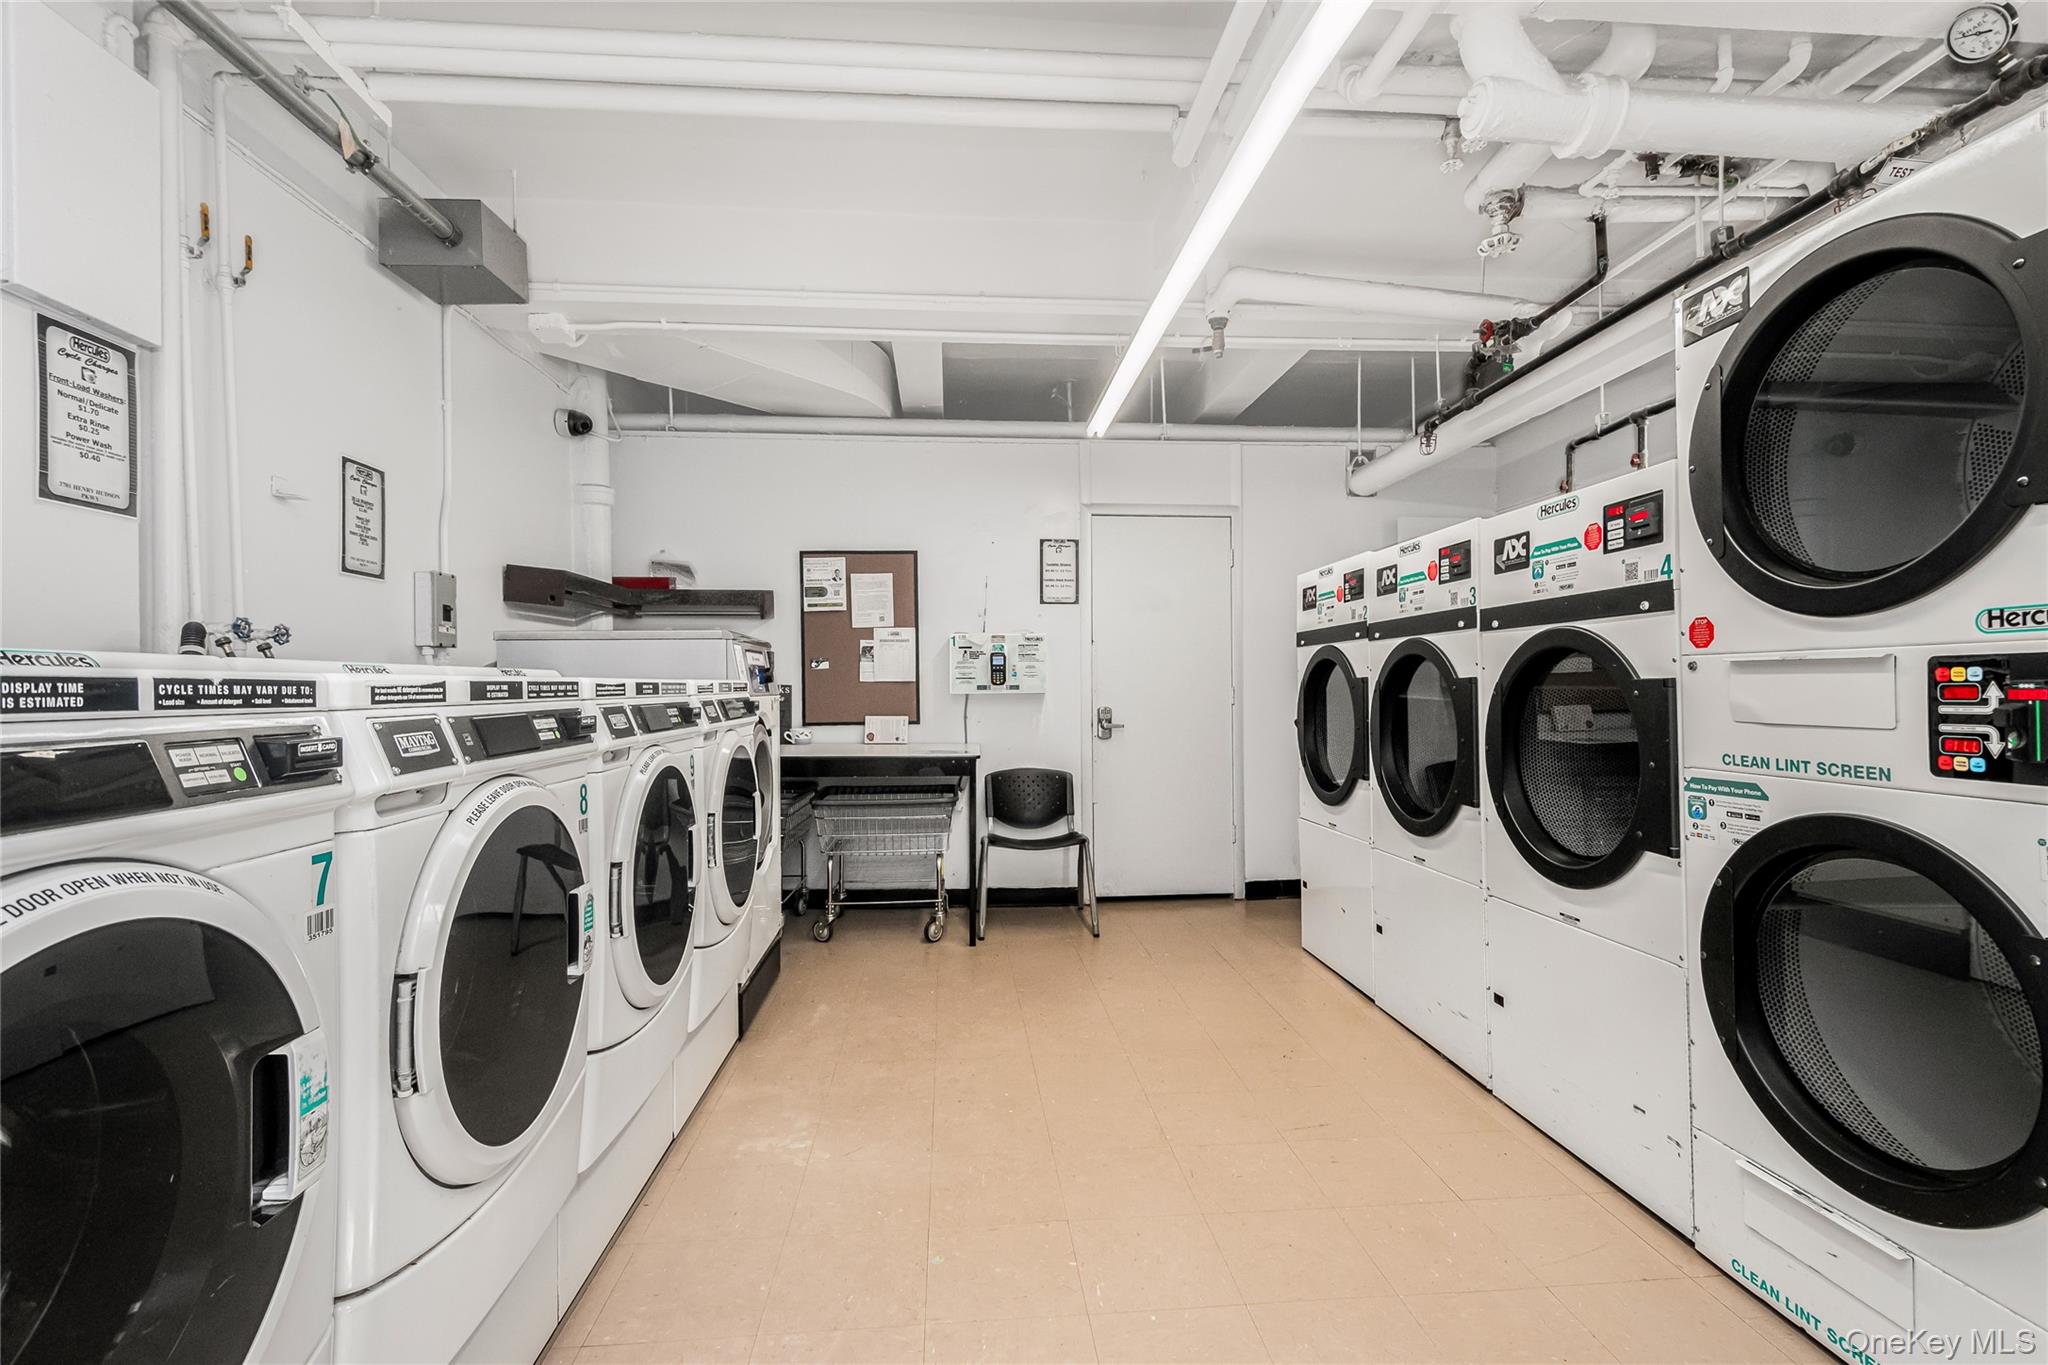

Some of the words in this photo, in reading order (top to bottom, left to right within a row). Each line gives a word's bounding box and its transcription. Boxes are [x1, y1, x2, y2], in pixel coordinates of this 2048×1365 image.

[1889, 166, 1915, 178] TEST
[72, 338, 108, 360] Hercules
[57, 347, 82, 361] Cycle
[85, 358, 119, 375] Charges
[48, 372, 91, 393] Front-Load
[57, 389, 119, 415] Normal/Delicate
[78, 404, 100, 416] $1.70
[67, 412, 88, 425] Extra
[90, 418, 111, 432] Rinse
[78, 424, 100, 436] $0.25
[65, 431, 90, 444] Power
[92, 438, 113, 450] Wash
[79, 451, 101, 463] $0.40
[1540, 498, 1577, 517] Hercules
[1502, 535, 1527, 561] ADC
[1660, 554, 1673, 580] 4
[1469, 586, 1477, 606] 3
[1363, 605, 1368, 620] 2
[2, 682, 53, 694] DISPLAY
[57, 682, 84, 694] TIME
[158, 684, 194, 695] CYCLE
[198, 685, 230, 695] TIMES
[233, 685, 252, 695] MAY
[256, 685, 278, 695] VARY
[281, 686, 297, 695] DUE
[300, 686, 313, 695] TO:
[2, 698, 15, 709] IS
[19, 697, 84, 709] ESTIMATED
[398, 734, 435, 748] MAYTAG
[690, 754, 694, 777] 9
[1722, 753, 1770, 770] CLEAN
[1776, 758, 1811, 773] LINT
[1817, 762, 1891, 782] SCREEN
[466, 802, 490, 825] PLEASE
[484, 786, 504, 805] LEAVE
[580, 783, 588, 815] 8
[312, 851, 333, 906] 7
[2, 888, 63, 918] DOOR
[60, 876, 110, 896] OPEN
[109, 871, 154, 885] WHEN
[153, 873, 182, 884] NOT
[184, 876, 199, 888] IN
[199, 879, 224, 895] USE
[1731, 1259, 1780, 1303] CLEAN
[1785, 1297, 1822, 1331] LINT
